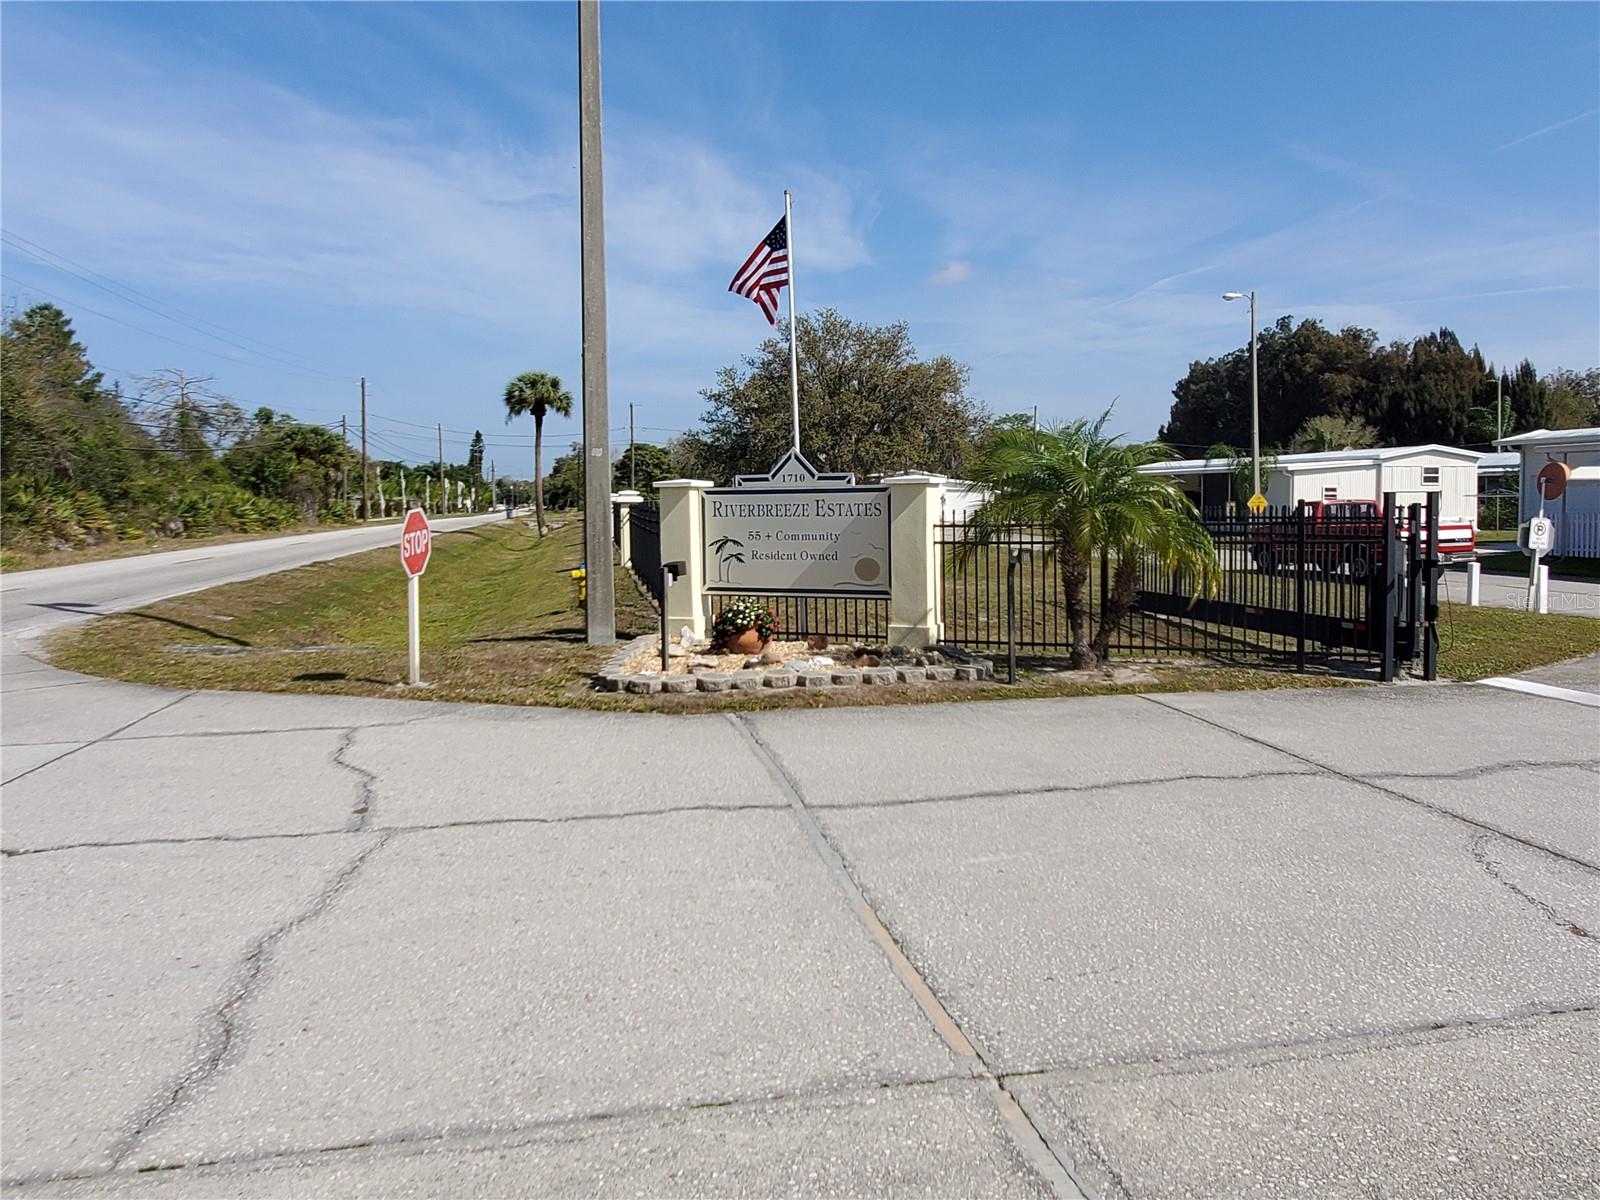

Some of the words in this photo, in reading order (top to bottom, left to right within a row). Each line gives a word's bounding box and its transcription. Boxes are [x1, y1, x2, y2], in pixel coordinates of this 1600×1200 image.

[782, 473, 806, 483] 1710
[712, 500, 809, 518] RIVERBREEZE
[815, 498, 882, 517] ESTATES
[775, 530, 841, 543] Community
[404, 529, 428, 558] STOP
[751, 550, 797, 560] Resident
[800, 551, 838, 561] Owned
